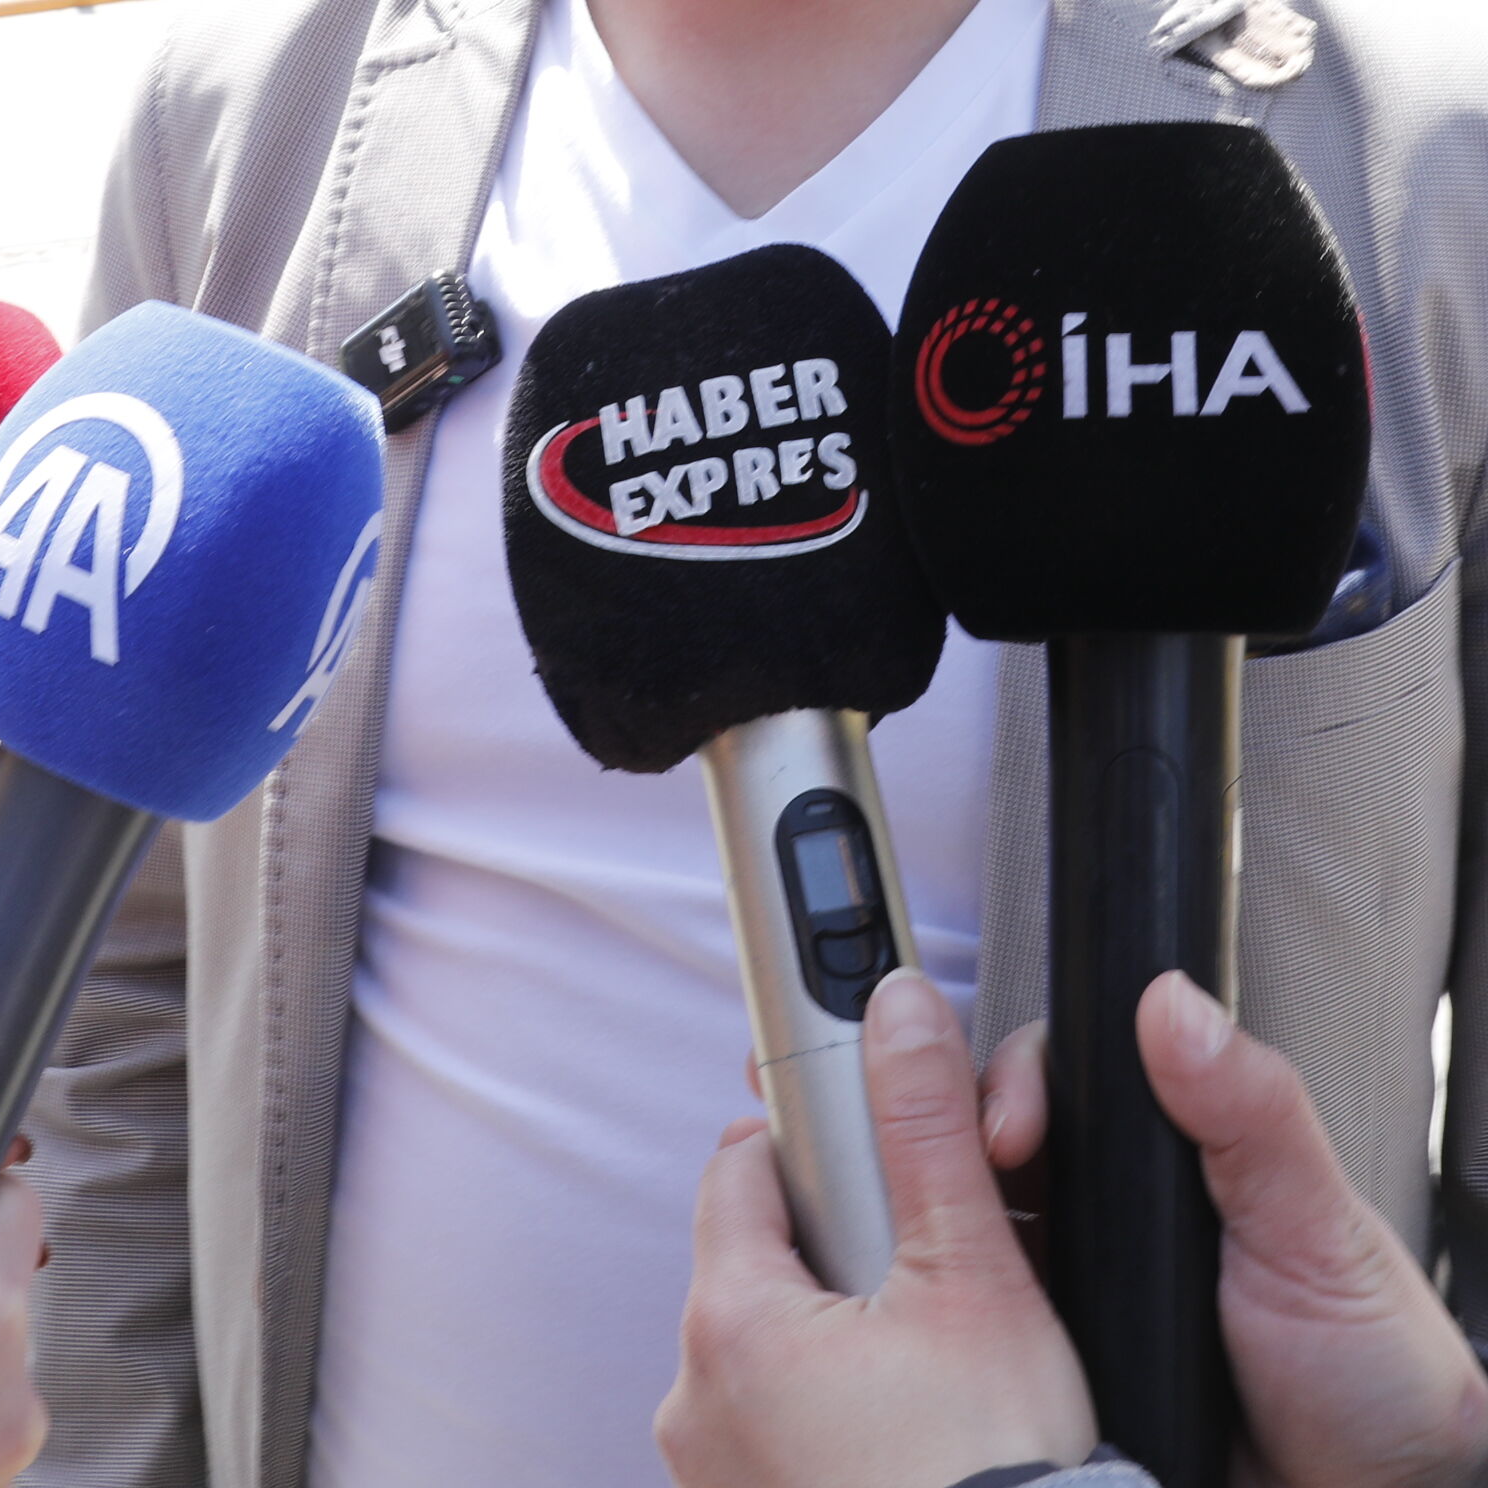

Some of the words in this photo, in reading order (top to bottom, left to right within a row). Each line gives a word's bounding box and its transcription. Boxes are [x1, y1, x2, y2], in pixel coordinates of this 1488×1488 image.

[598, 357, 849, 467] HABER
[1060, 311, 1311, 420] İHA
[607, 431, 859, 538] EXPRES
